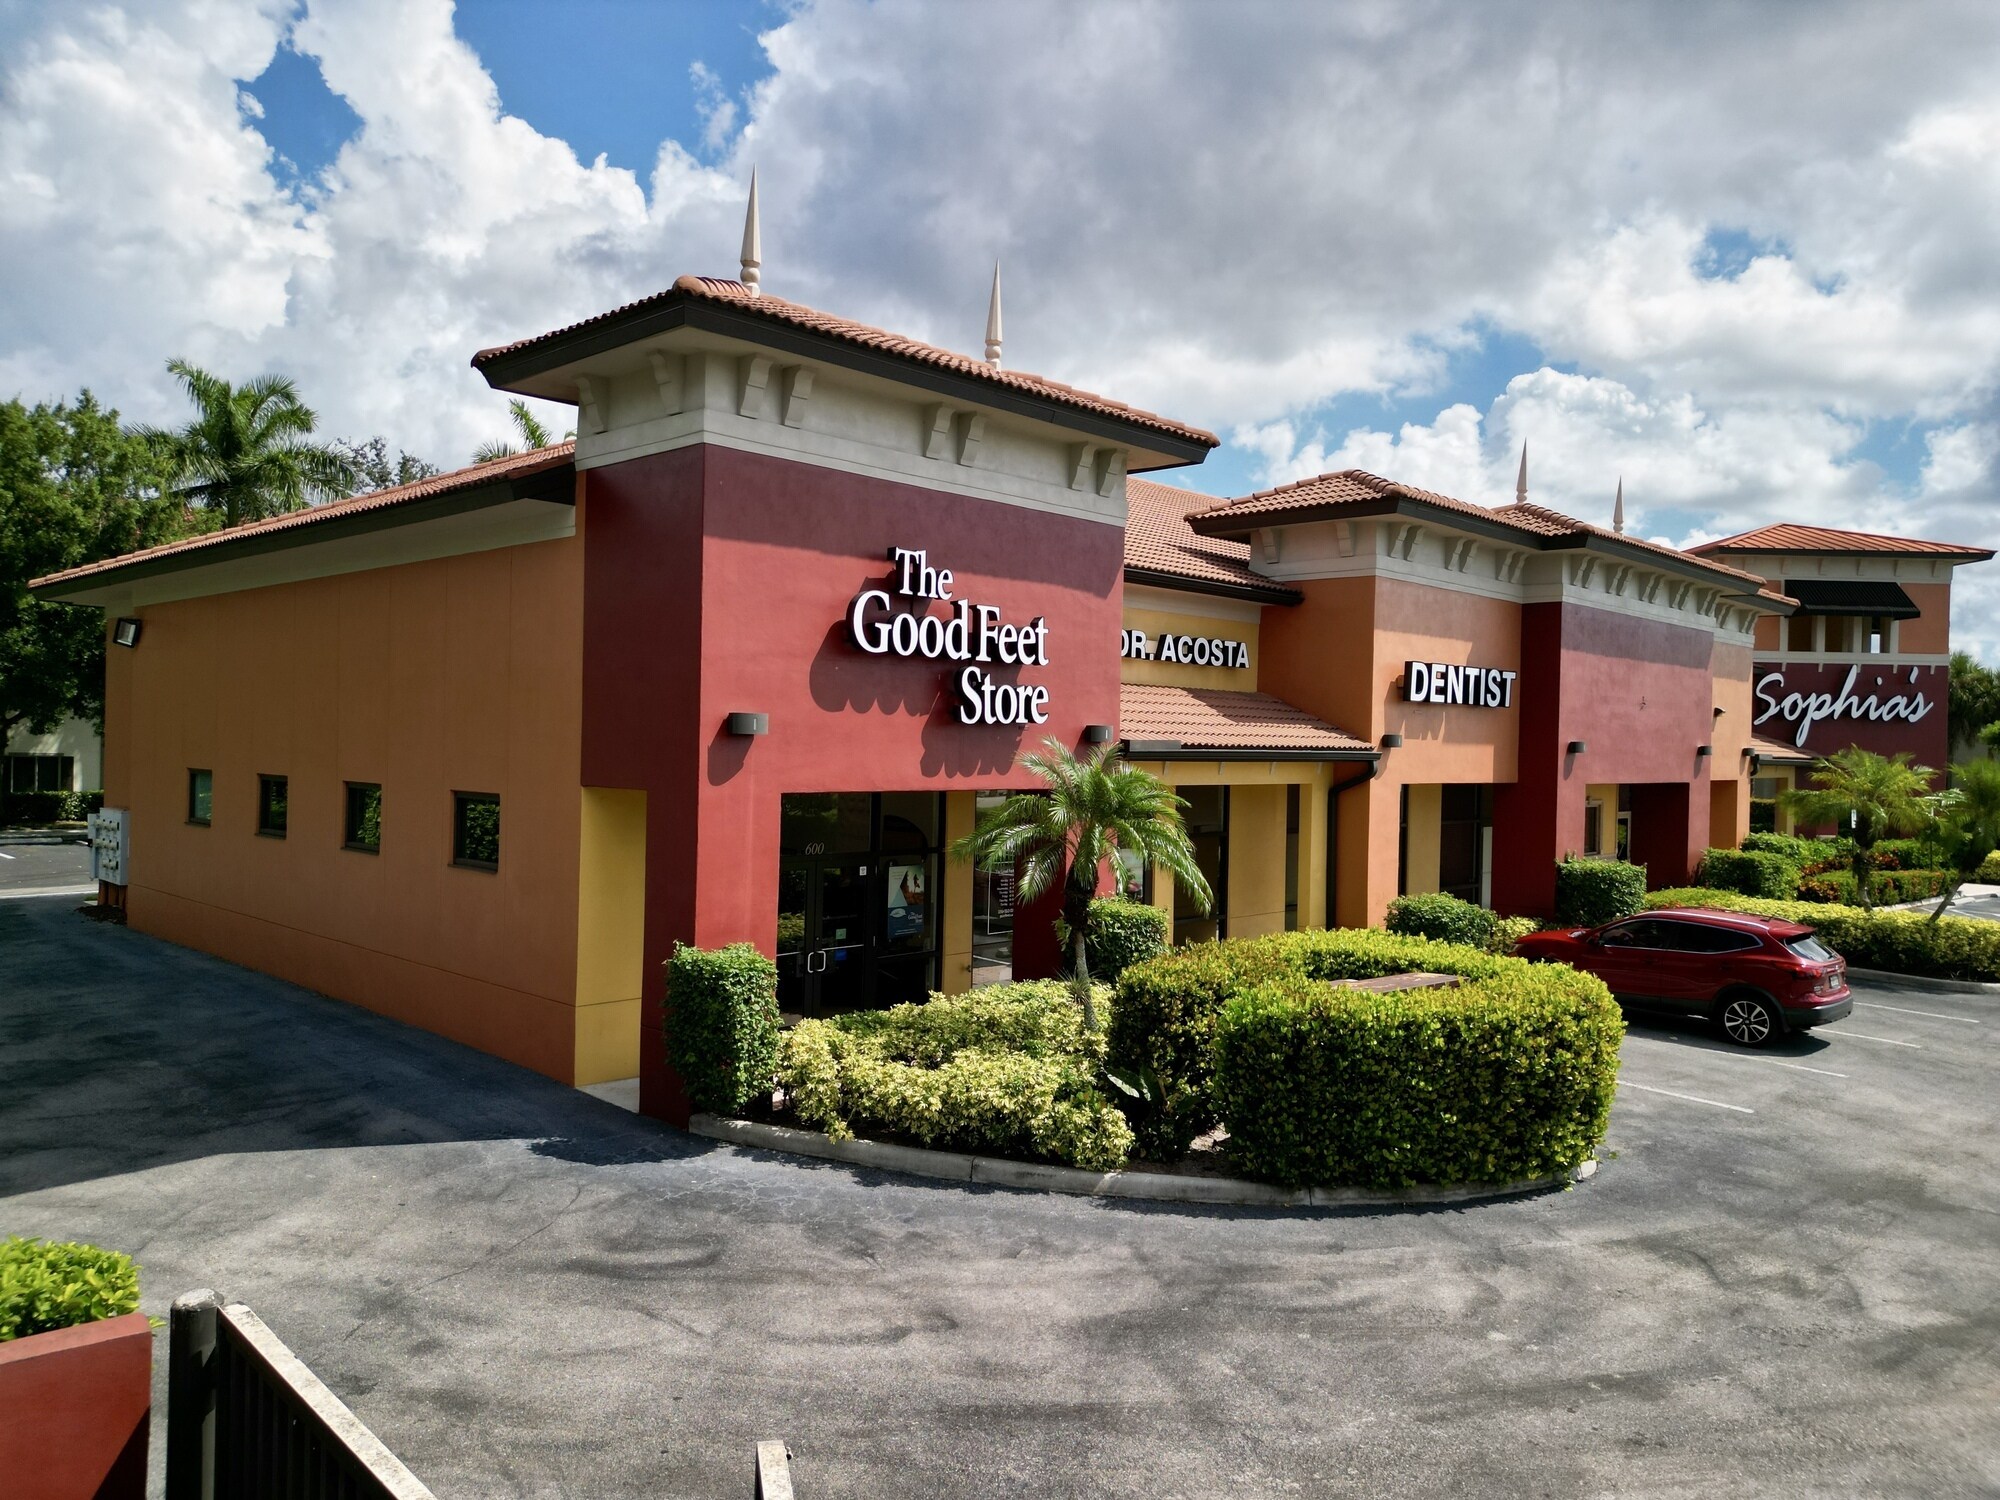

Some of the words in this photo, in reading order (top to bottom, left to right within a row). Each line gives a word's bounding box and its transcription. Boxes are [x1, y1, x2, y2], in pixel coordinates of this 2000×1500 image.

[895, 547, 954, 600] The
[853, 590, 971, 660] Good
[975, 604, 1049, 666] Feet
[1121, 629, 1154, 660] DR.
[1161, 634, 1250, 668] ACOSTA
[960, 666, 1049, 725] Store
[1410, 661, 1517, 707] DENTIST
[1753, 664, 1934, 748] Sophia's
[805, 842, 825, 855] 600
